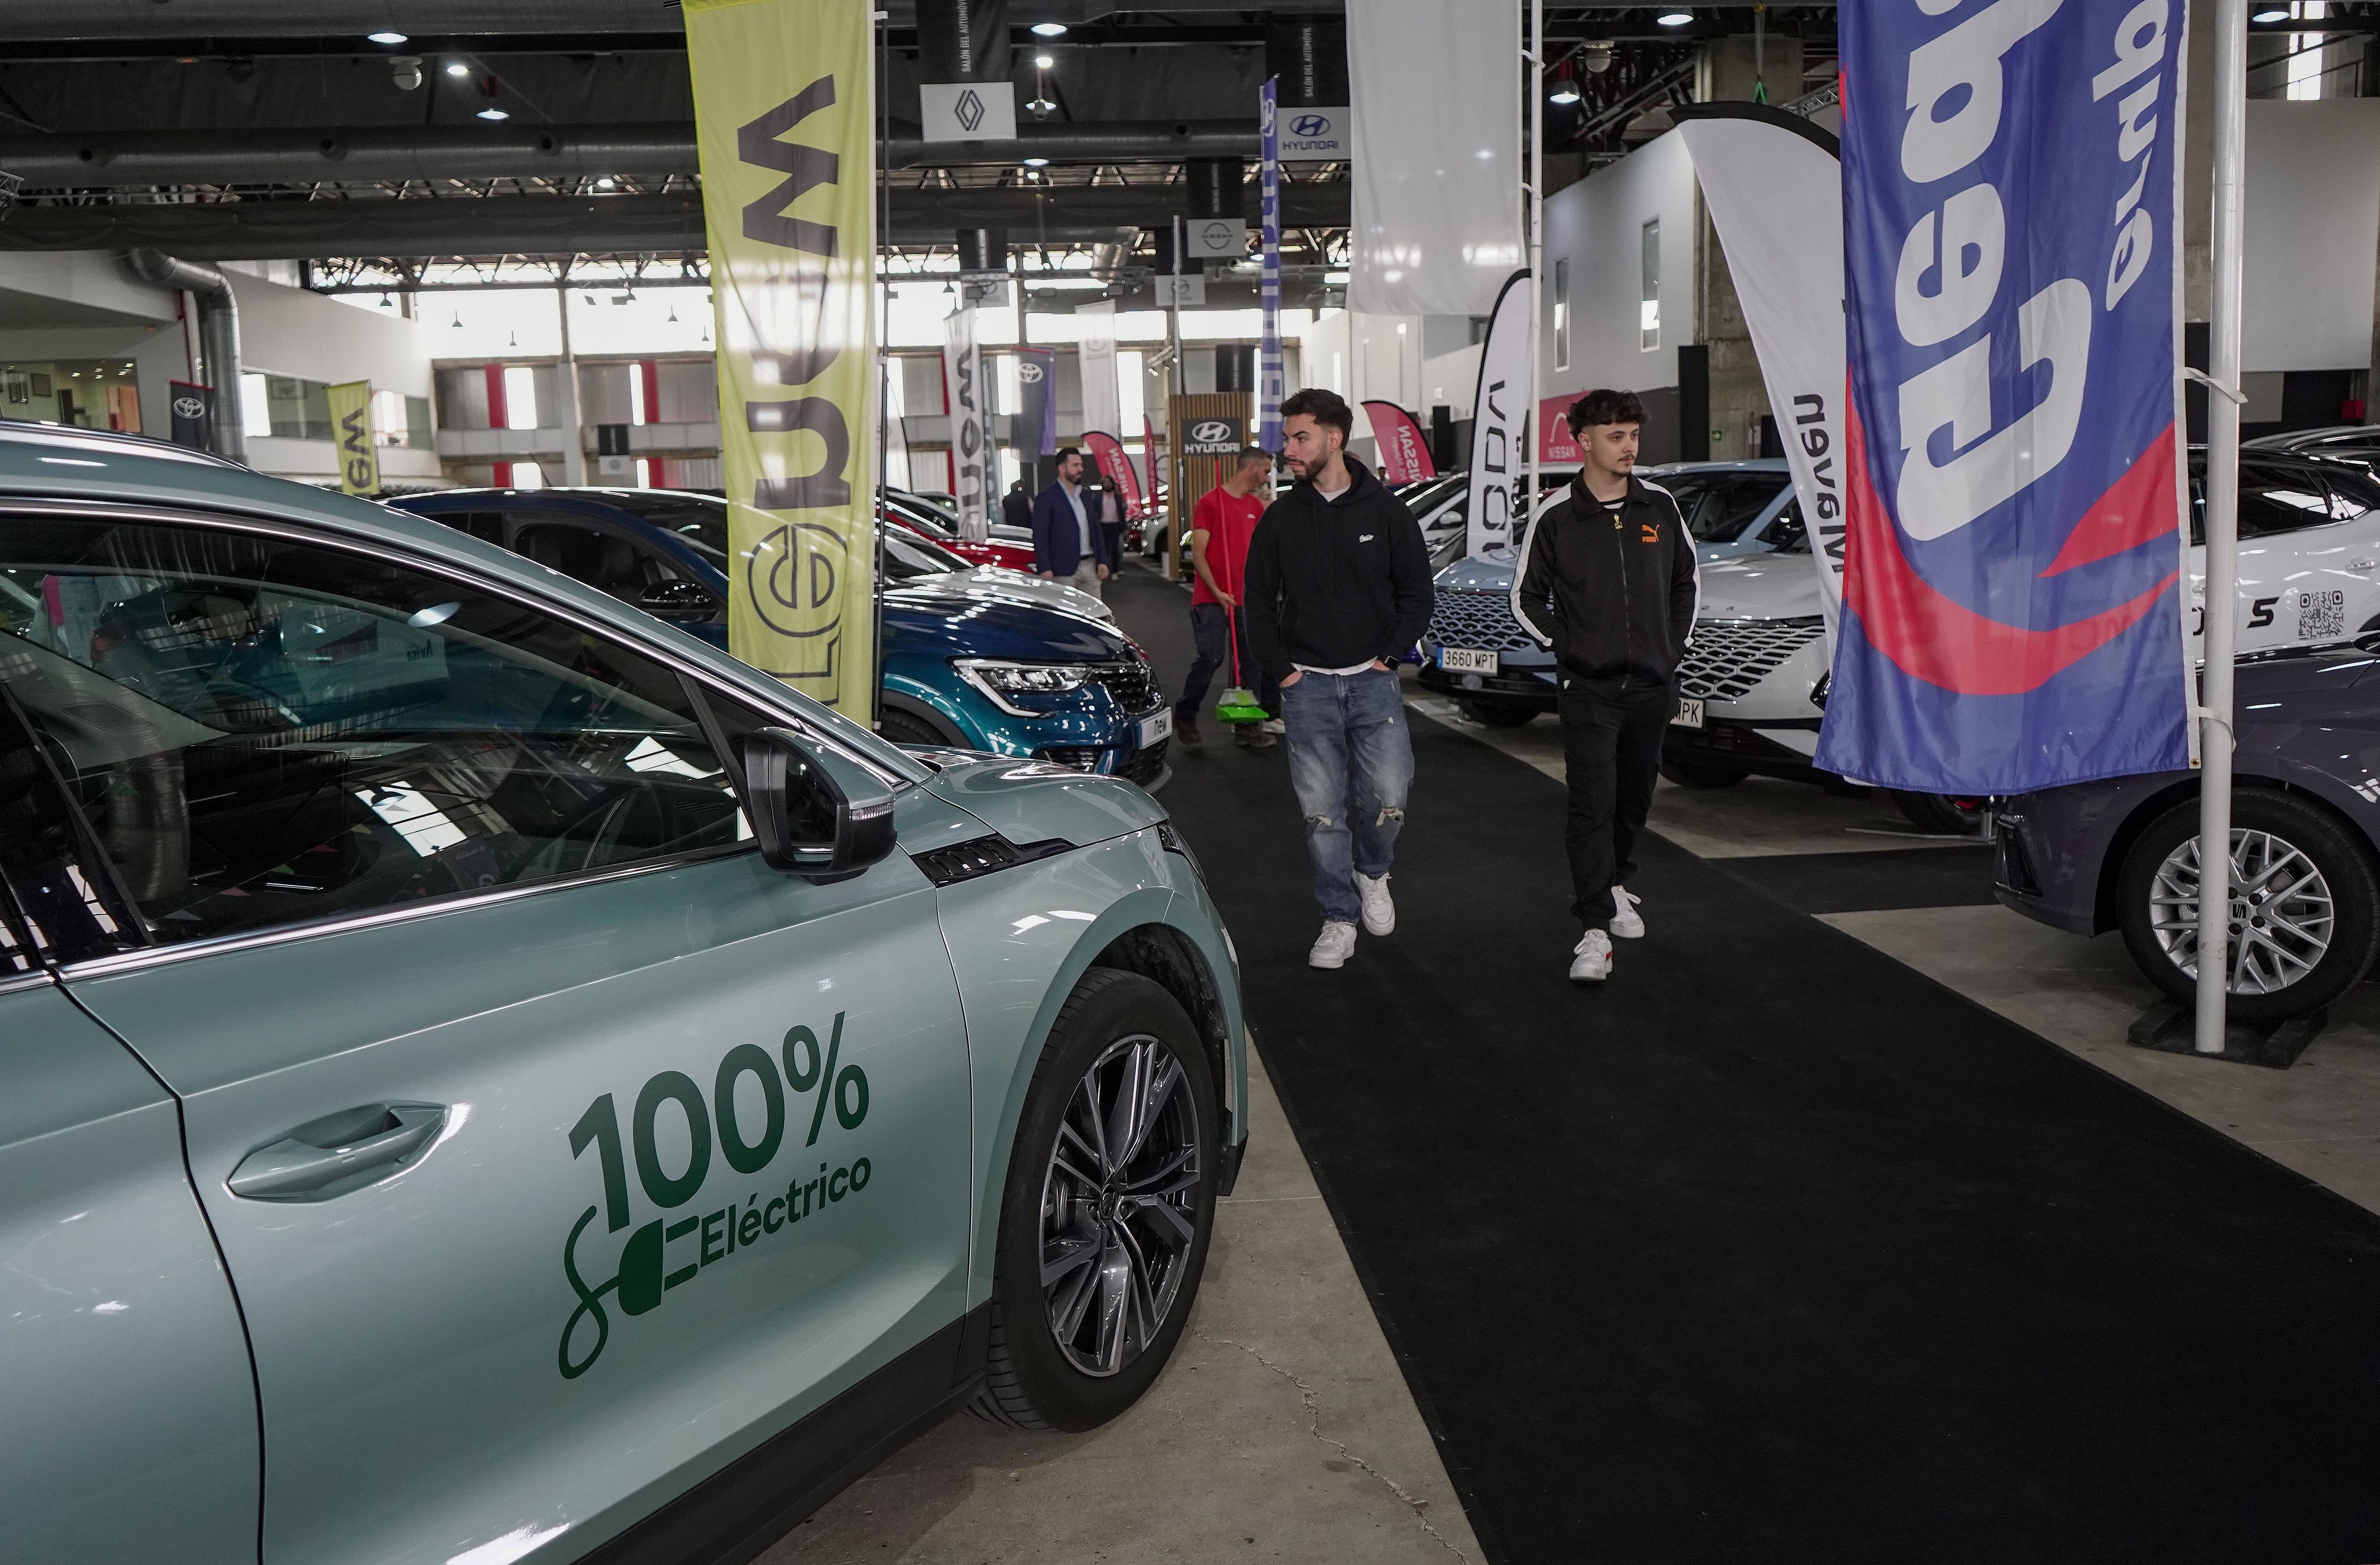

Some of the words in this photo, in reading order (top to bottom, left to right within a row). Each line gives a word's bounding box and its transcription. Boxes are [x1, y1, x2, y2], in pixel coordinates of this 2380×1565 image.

[959, 36, 970, 48] DEL
[1282, 140, 1339, 150] HYUNDAI
[1184, 442, 1240, 454] HYUNDAI
[1548, 445, 1576, 460] NISSAN
[1445, 650, 1472, 666] 3660
[568, 1011, 870, 1234] 100%
[700, 1157, 871, 1269] Eléctrico
